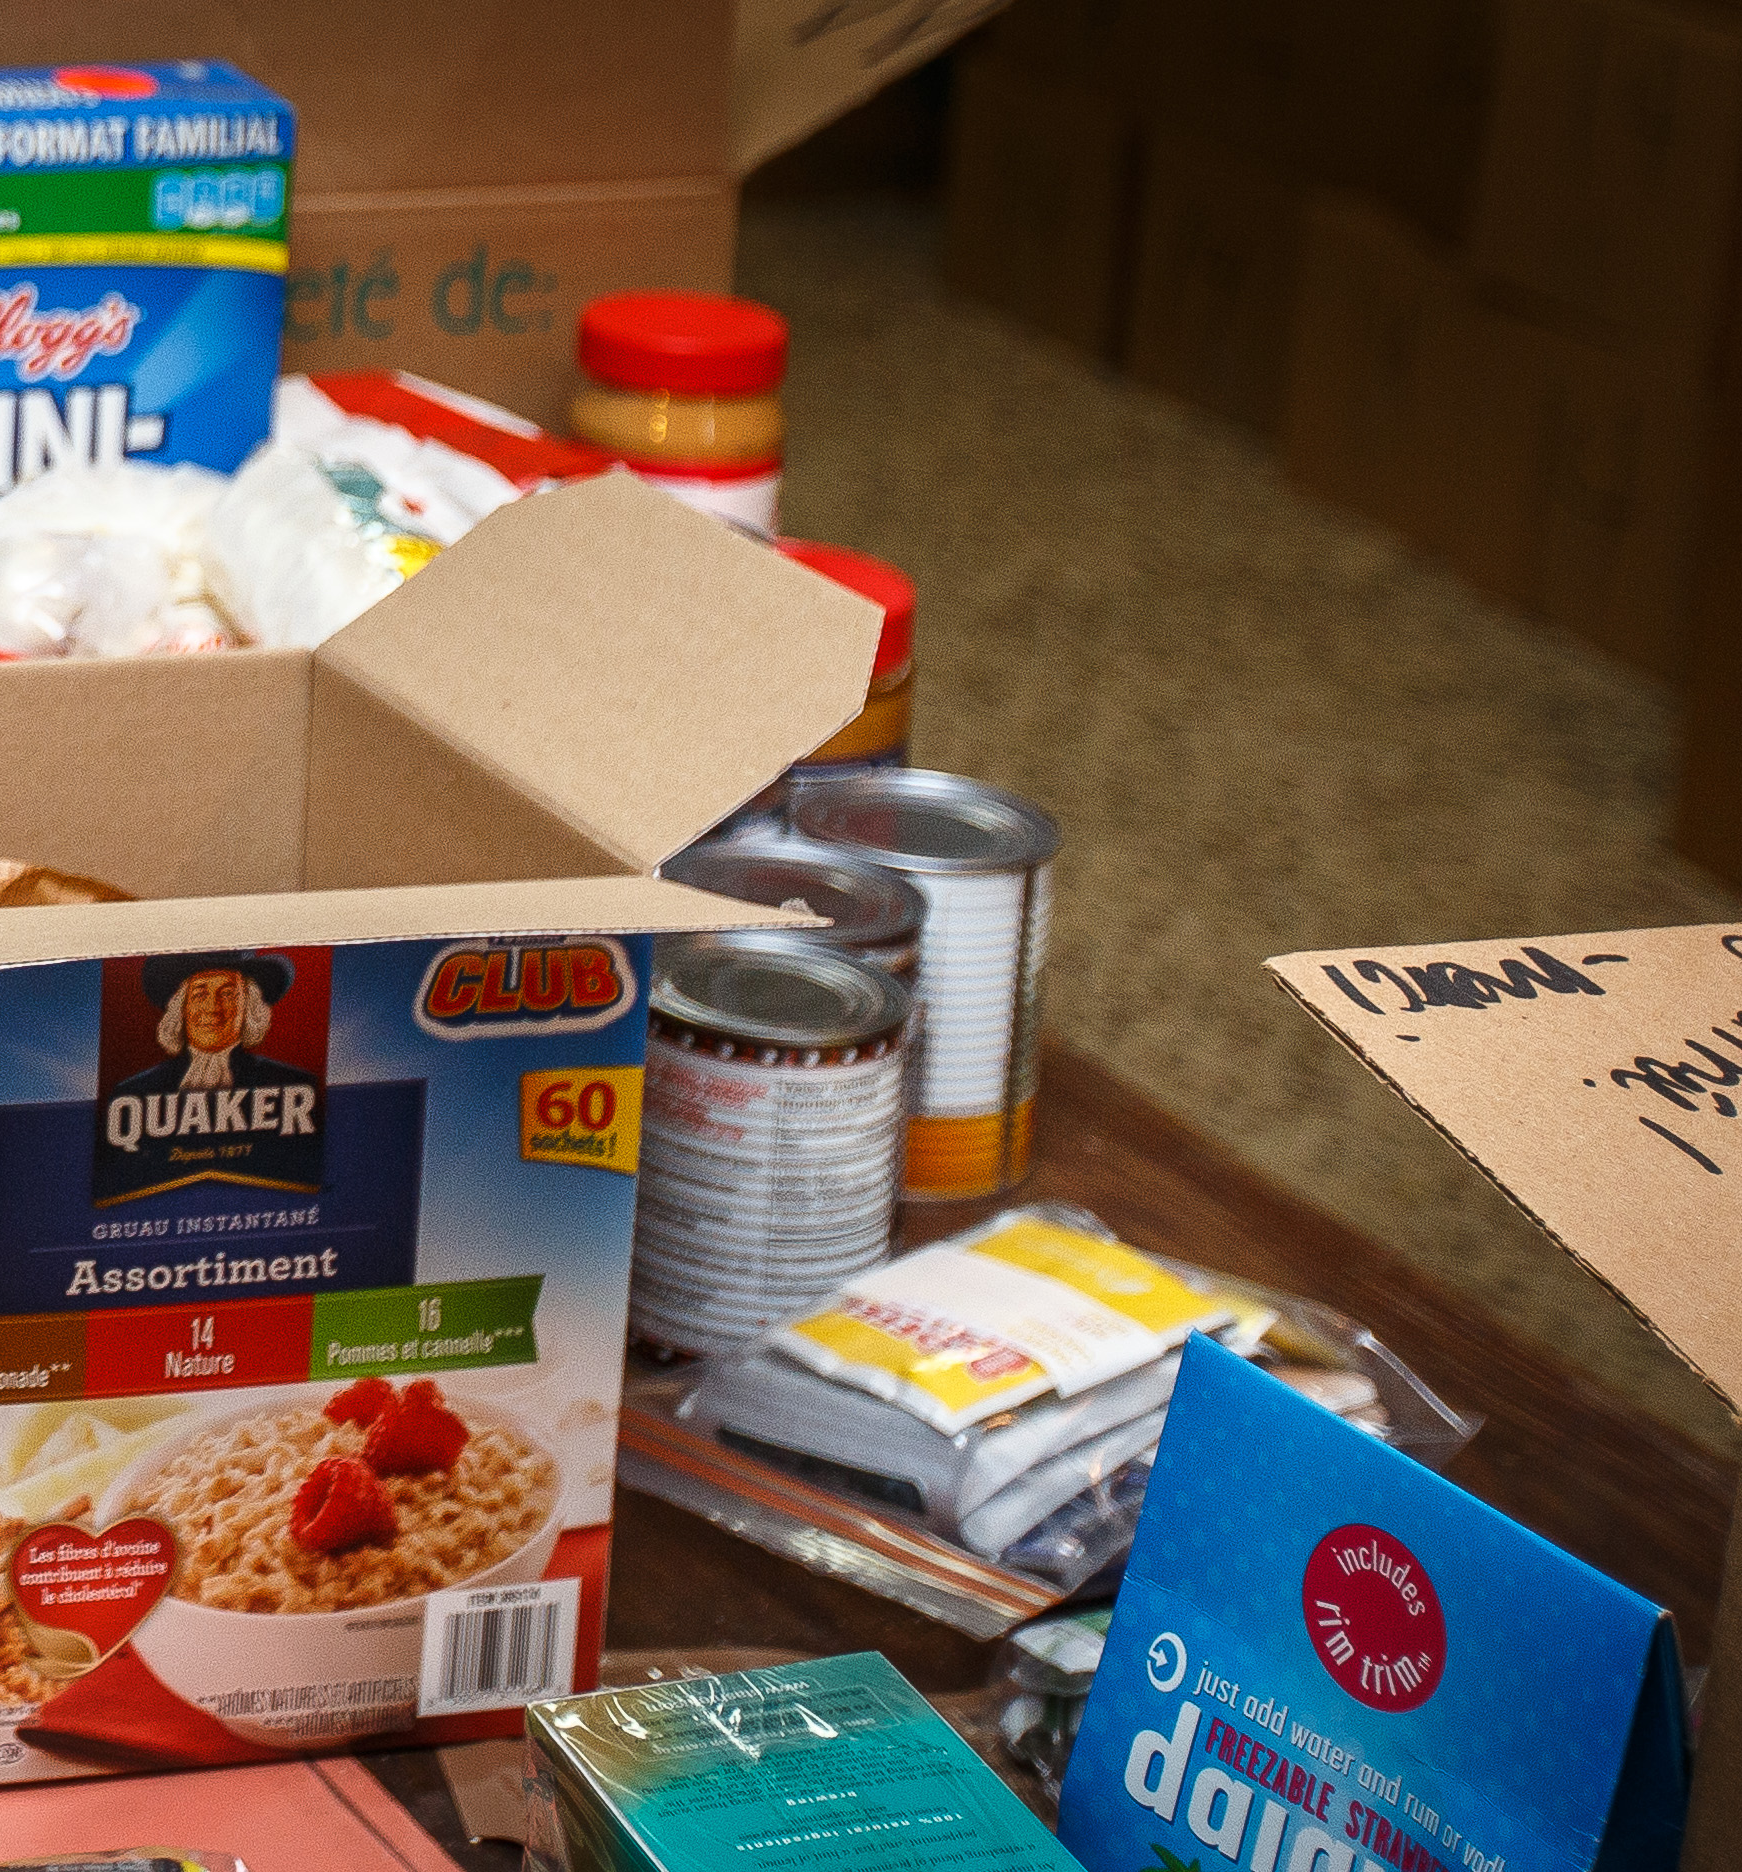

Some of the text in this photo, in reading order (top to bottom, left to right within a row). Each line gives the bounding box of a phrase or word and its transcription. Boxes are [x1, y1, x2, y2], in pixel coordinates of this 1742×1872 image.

[131, 114, 285, 160] FAMILIAL
[426, 950, 624, 1019] CLUB
[106, 1084, 316, 1152] QUAKER
[537, 1079, 616, 1132] 60
[92, 1205, 321, 1242] GRUAU INSTANTANÉ
[66, 1246, 339, 1298] Assortiment
[189, 1316, 216, 1350] 14
[417, 1298, 442, 1332] 16
[164, 1349, 237, 1381] Nature
[326, 1336, 399, 1368] Pommes
[400, 1337, 419, 1360] et
[1331, 1539, 1426, 1617] includes
[1315, 1599, 1356, 1667] rim
[1193, 1660, 1245, 1709] just
[1243, 1694, 1289, 1737] add
[1290, 1720, 1359, 1777] water
[1358, 1763, 1403, 1806] and
[1404, 1791, 1440, 1838] rum
[1441, 1823, 1463, 1853] or
[1204, 1717, 1337, 1822] FREEZABLE
[785, 1790, 857, 1806] brewing
[735, 1830, 839, 1852] ingredients
[844, 1819, 911, 1835] natural
